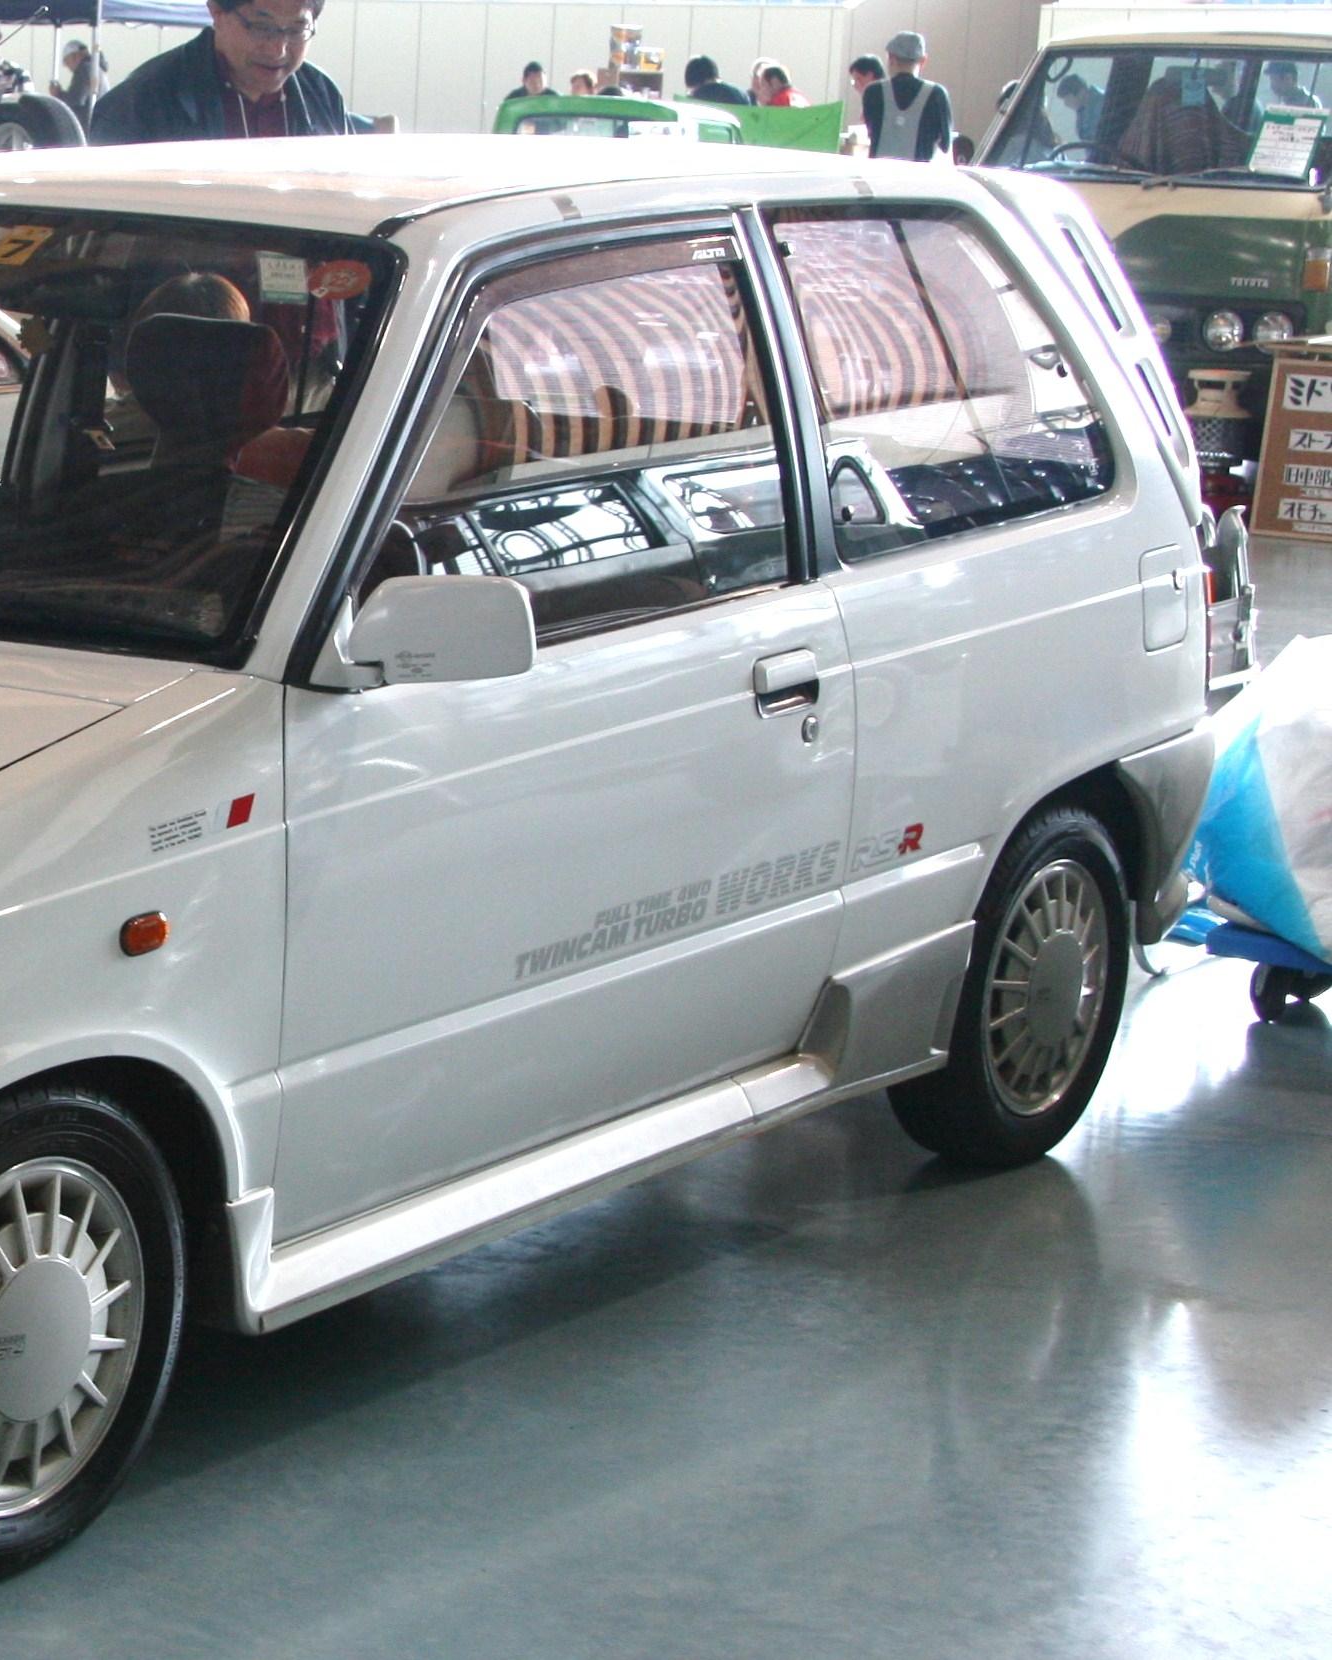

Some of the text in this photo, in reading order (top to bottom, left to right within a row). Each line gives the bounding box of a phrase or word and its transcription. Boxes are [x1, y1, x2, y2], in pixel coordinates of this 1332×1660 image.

[0, 238, 35, 259] 7
[1230, 276, 1270, 289] TOYOTA
[1288, 376, 1332, 407] ミド
[1284, 465, 1332, 485] 旧車部
[1283, 501, 1328, 521] オモチャ
[715, 841, 841, 916] WORKS
[594, 880, 713, 929] FULL TIME 4WD
[514, 898, 709, 980] TWINCAM TURBO
